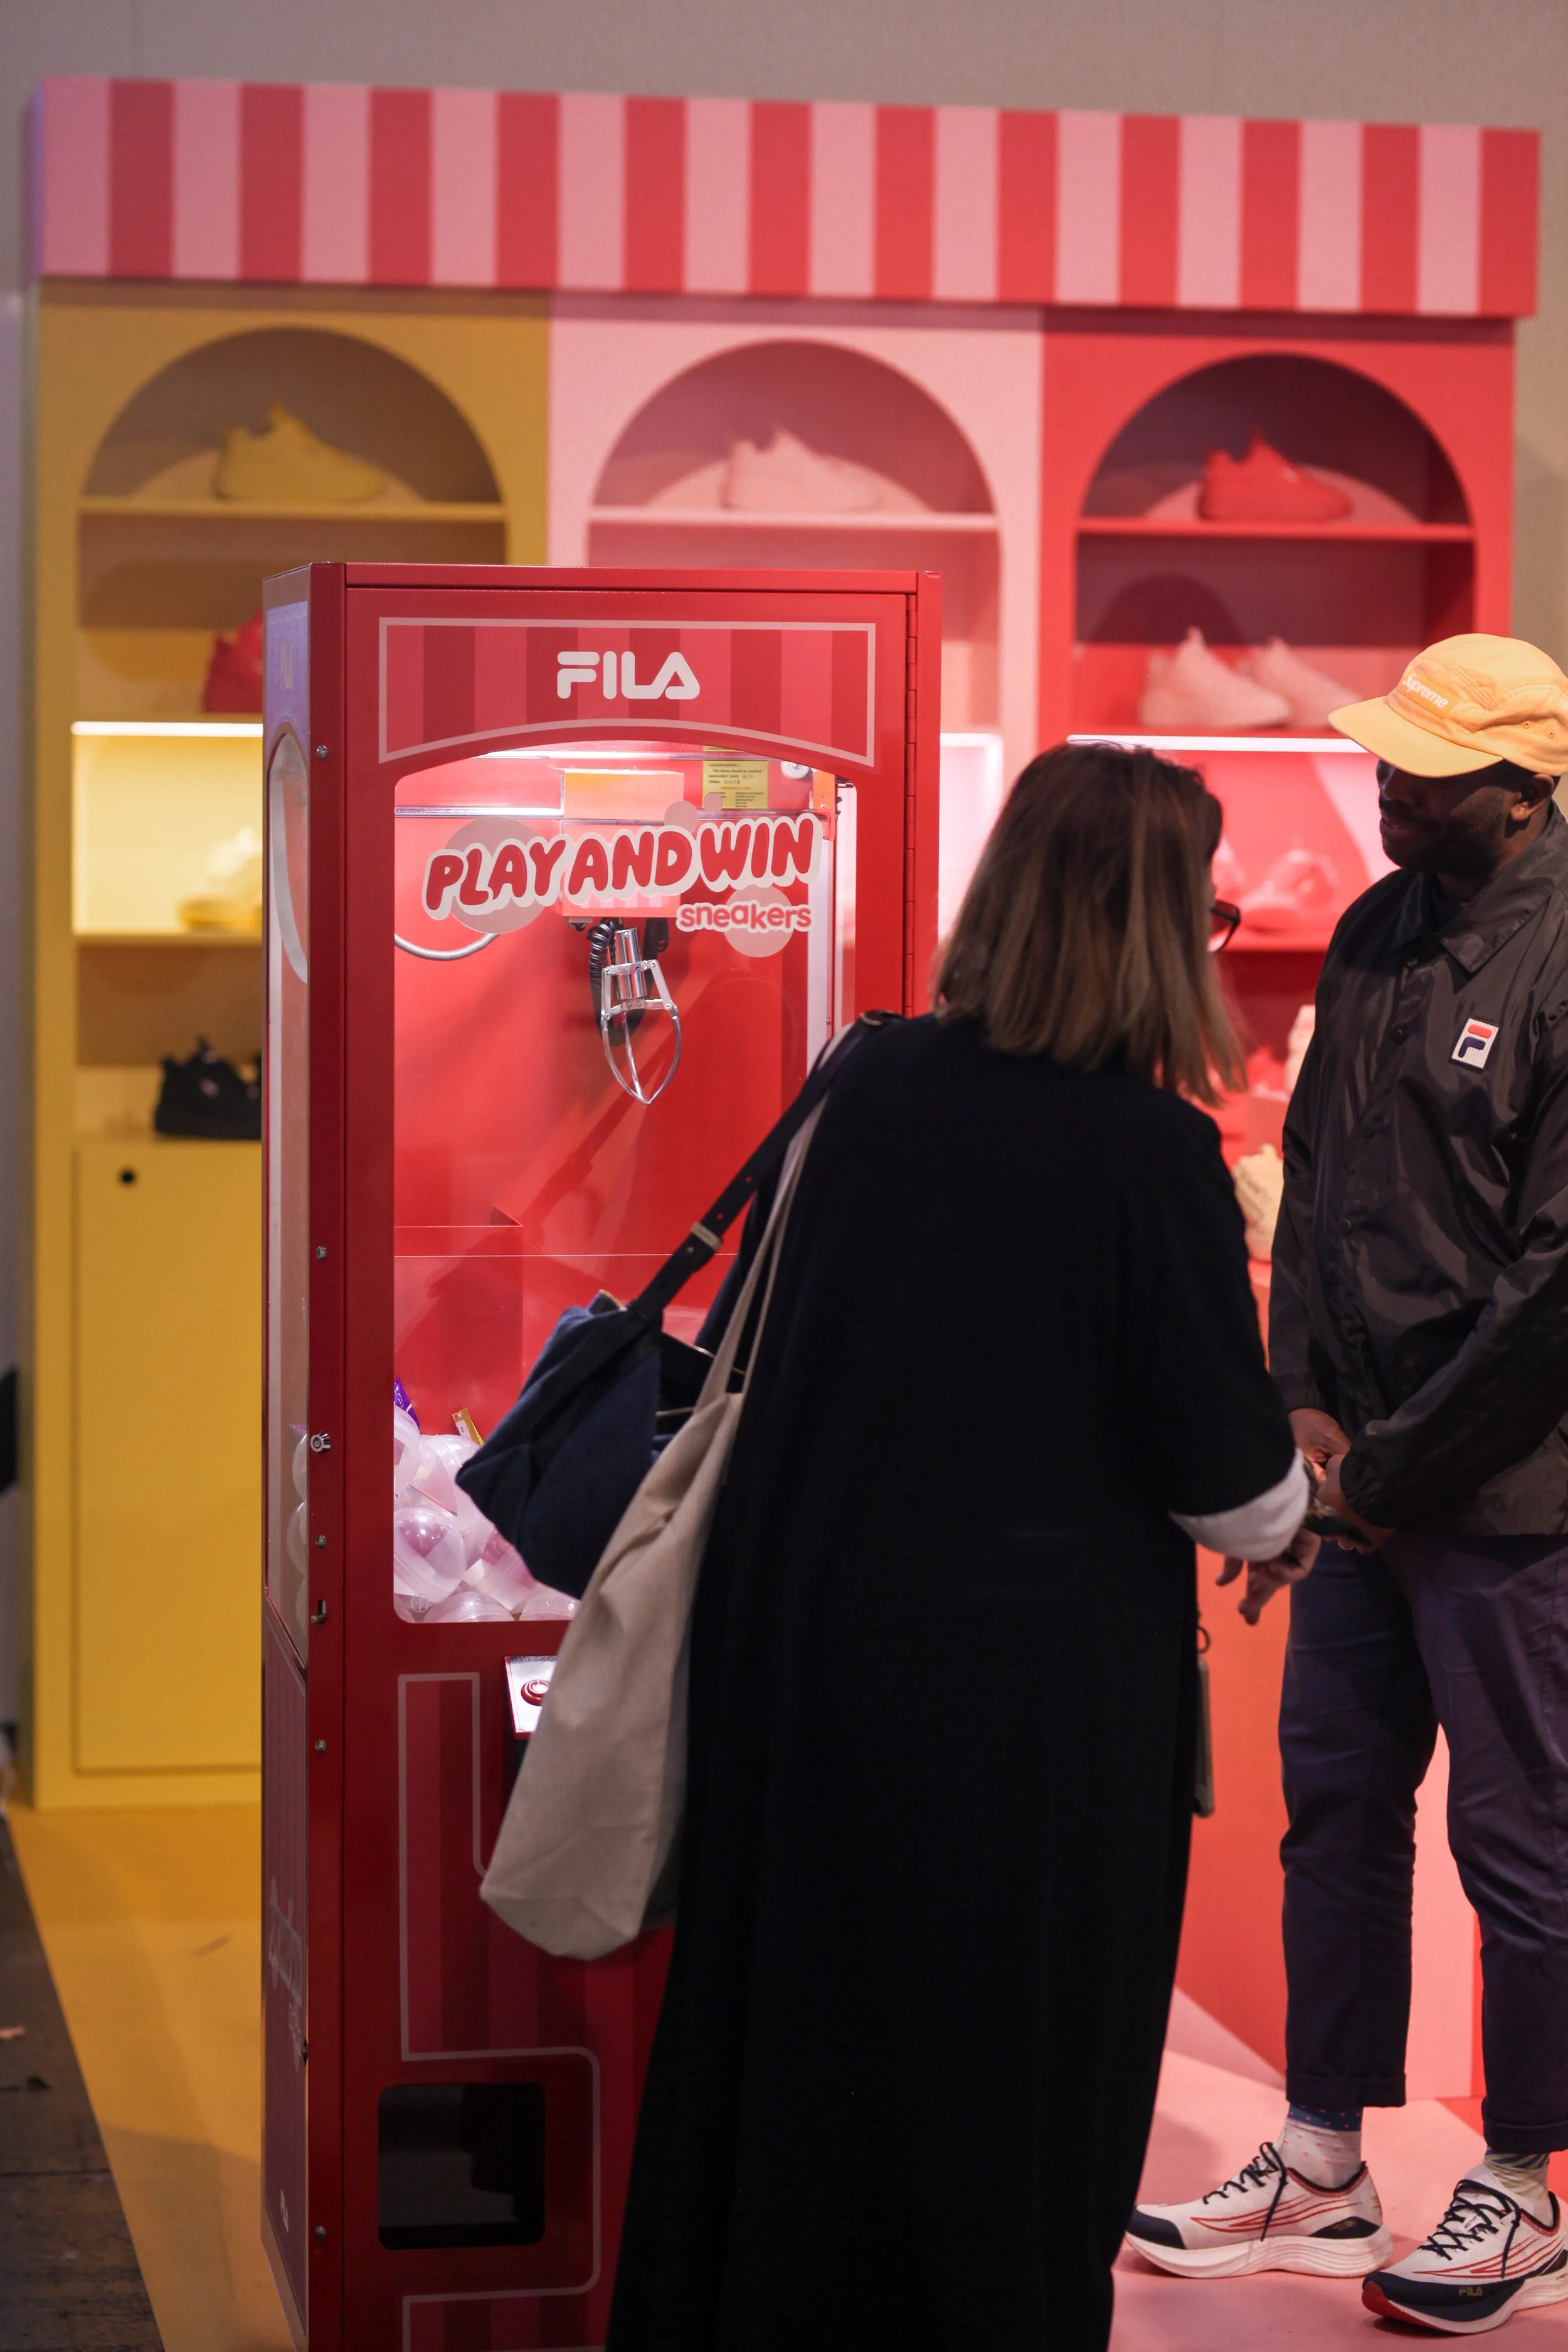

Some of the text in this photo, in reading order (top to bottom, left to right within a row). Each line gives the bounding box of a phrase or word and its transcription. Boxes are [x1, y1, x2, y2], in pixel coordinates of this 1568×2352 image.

[557, 650, 701, 700] FILA
[425, 818, 813, 911] PLAY AND WIN
[681, 903, 813, 931] sneakers
[1458, 2286, 1483, 2296] FILA
